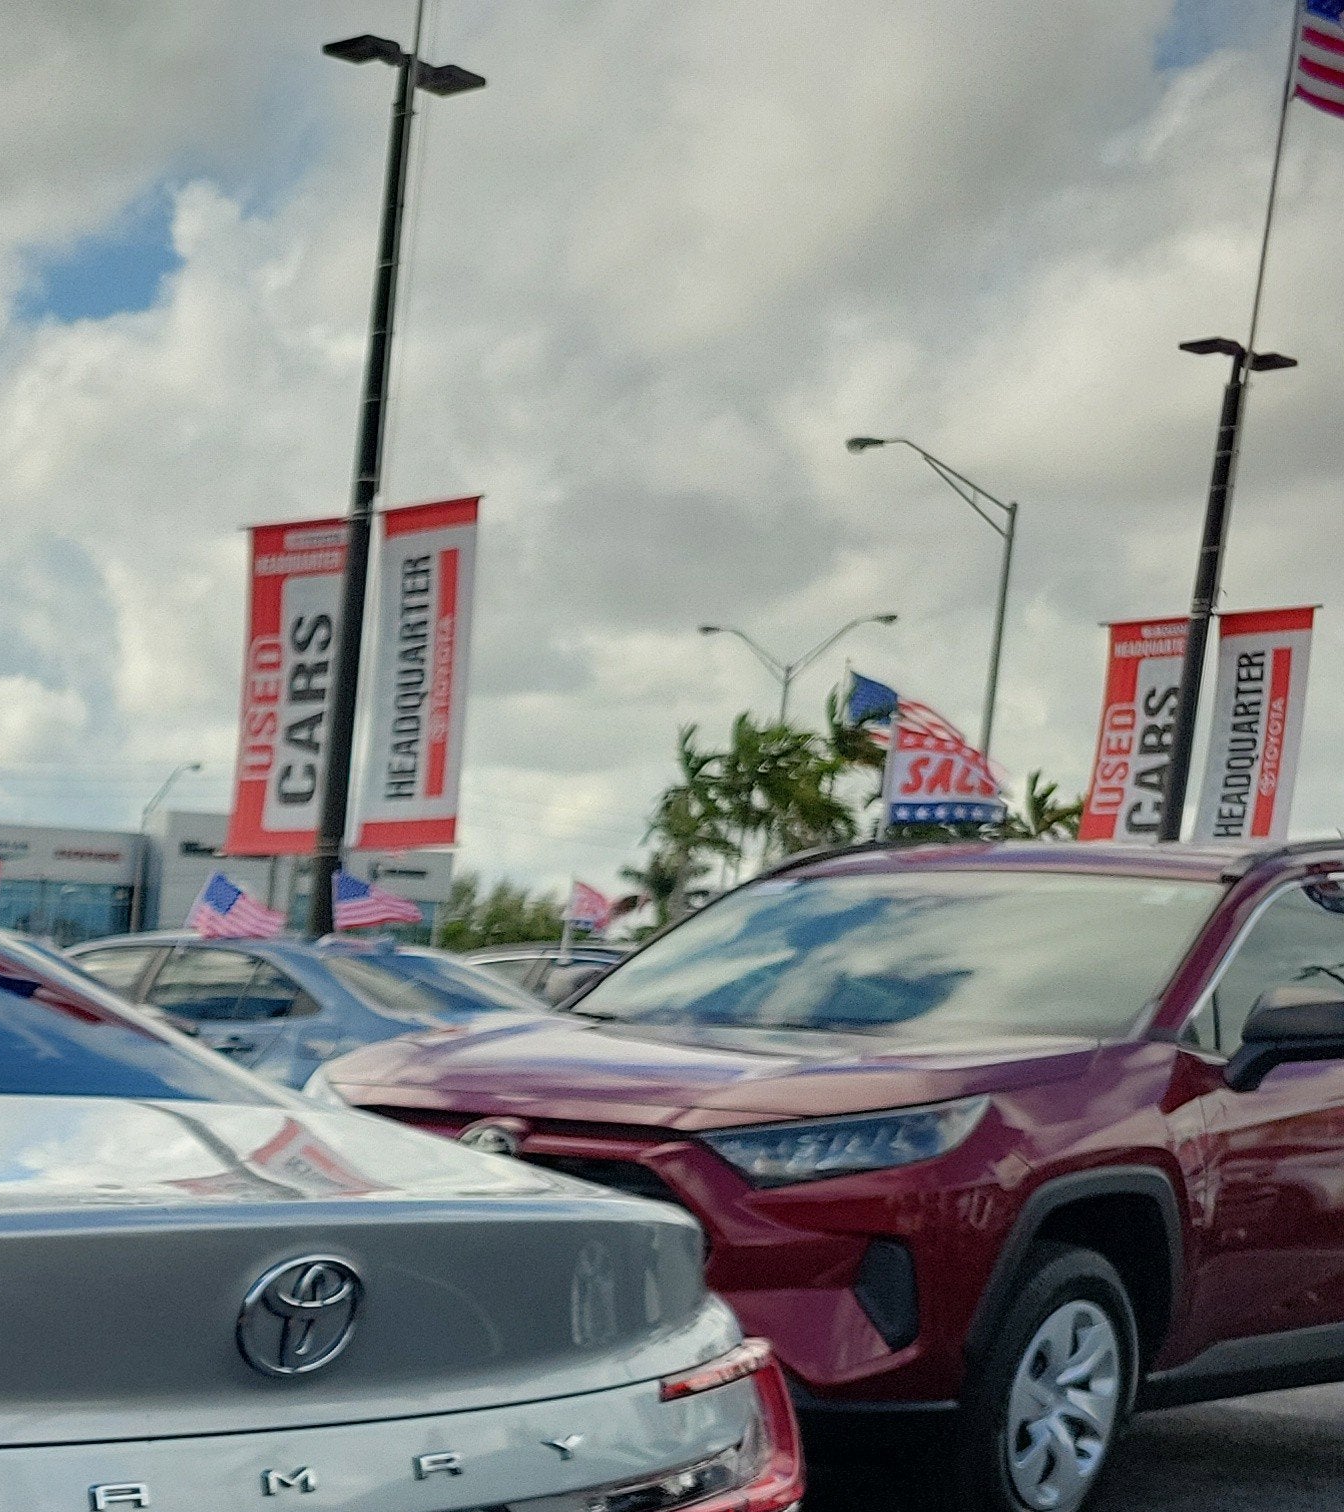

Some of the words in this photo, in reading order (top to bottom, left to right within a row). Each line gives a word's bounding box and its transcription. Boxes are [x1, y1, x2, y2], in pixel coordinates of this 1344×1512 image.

[242, 638, 284, 773] USED
[279, 613, 333, 804] CARS
[385, 555, 431, 798] HEADQUARTER
[1213, 650, 1265, 838] HEADQUARTER
[1262, 697, 1285, 773] TOYOTA
[900, 757, 995, 796] SAL
[1094, 706, 1137, 810] USED
